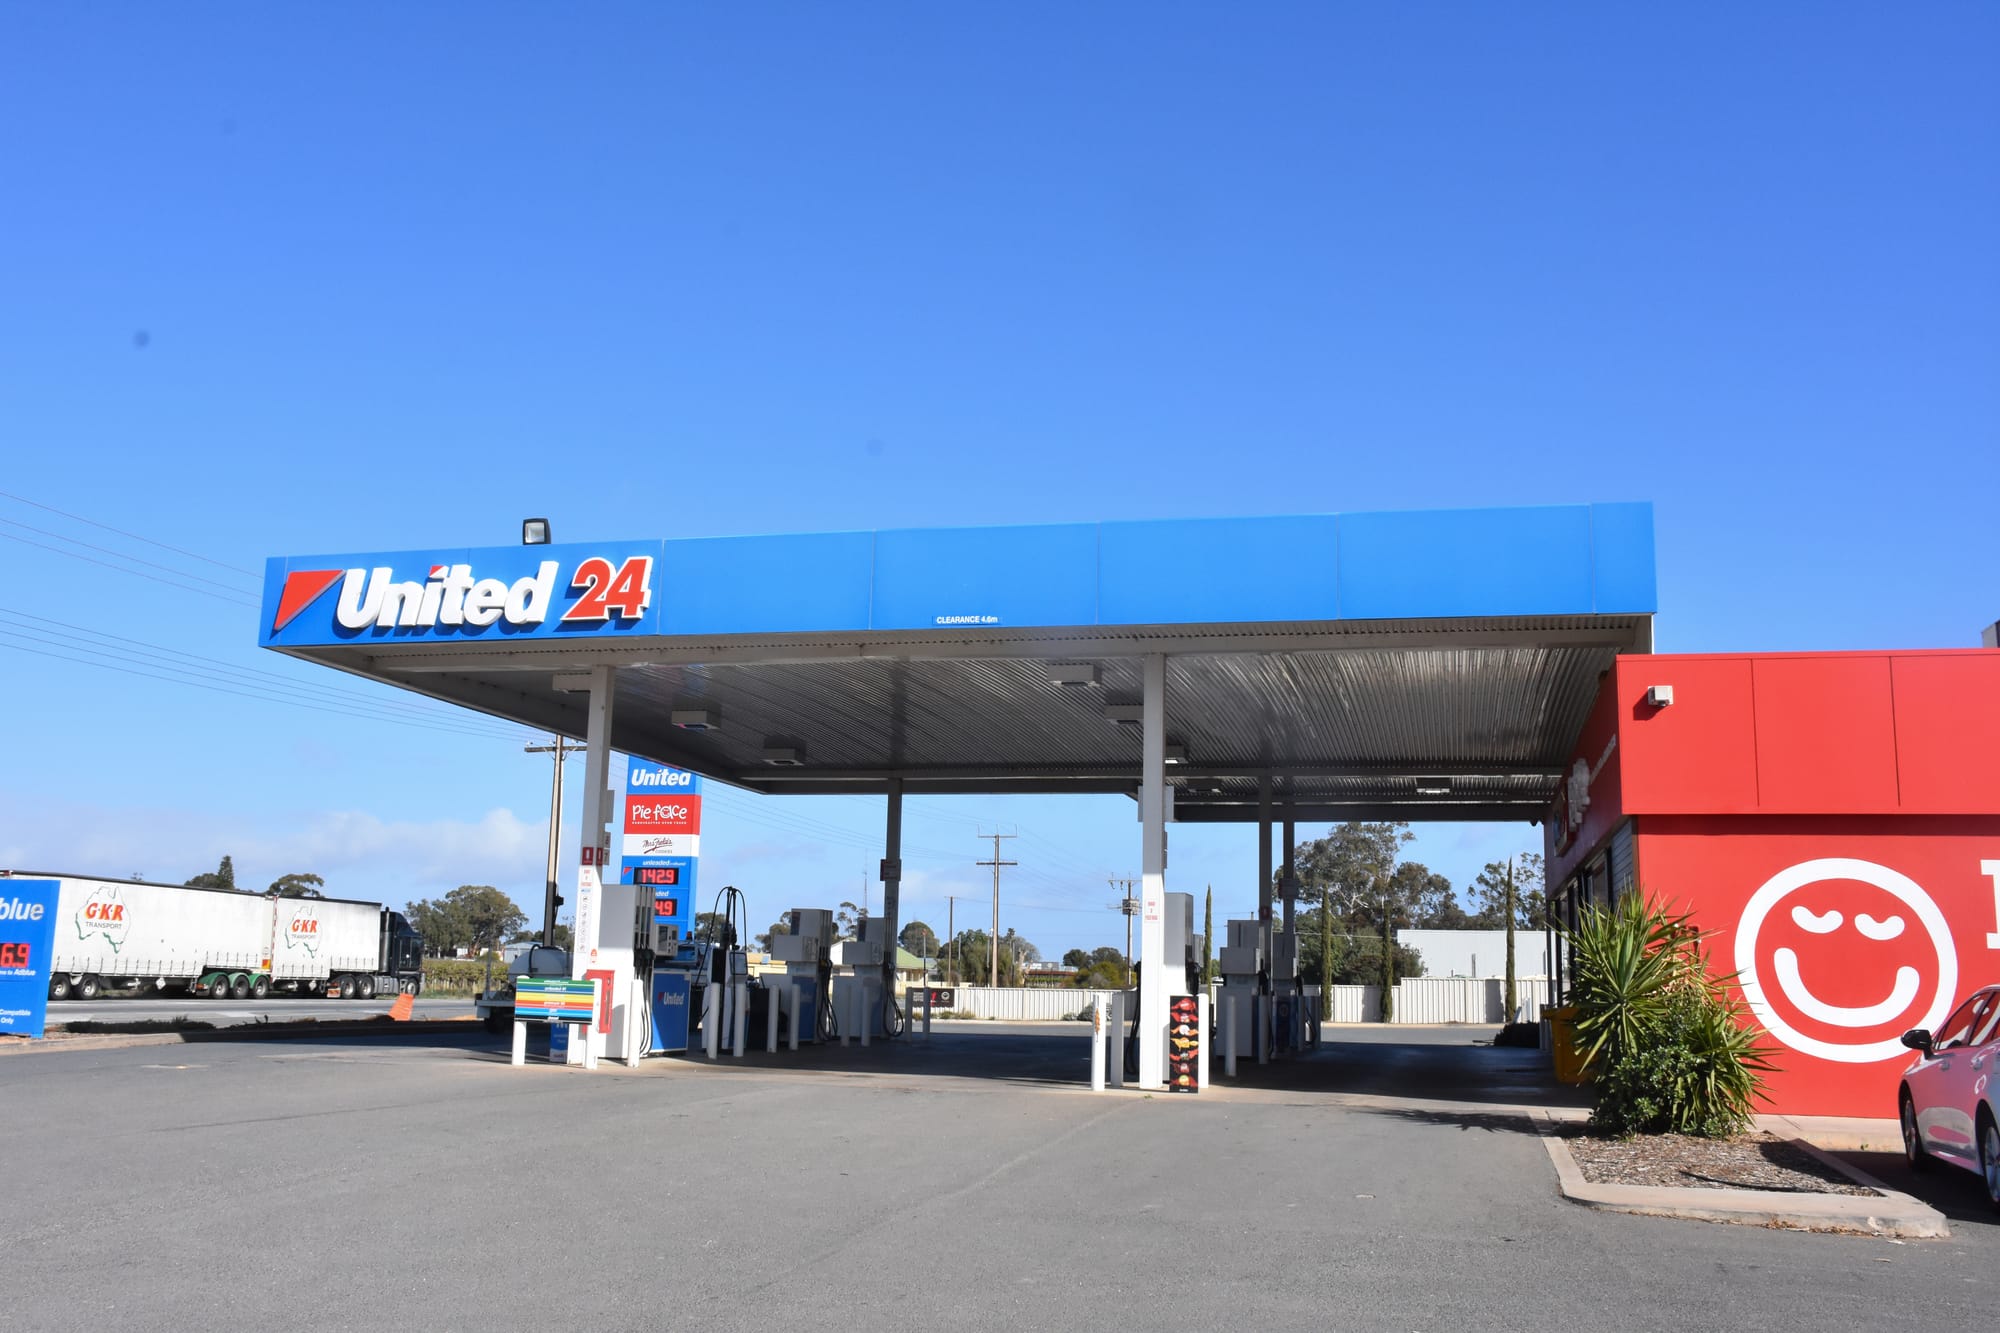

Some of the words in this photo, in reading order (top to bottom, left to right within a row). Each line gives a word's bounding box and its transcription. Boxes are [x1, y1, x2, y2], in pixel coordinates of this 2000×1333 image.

[337, 560, 559, 629] United
[560, 556, 653, 622] 24
[936, 615, 980, 624] CLEARANCE
[980, 615, 998, 624] 4.6m
[653, 804, 687, 821] face
[86, 921, 123, 930] TRANSPORT
[1, 1016, 14, 1025] Only
